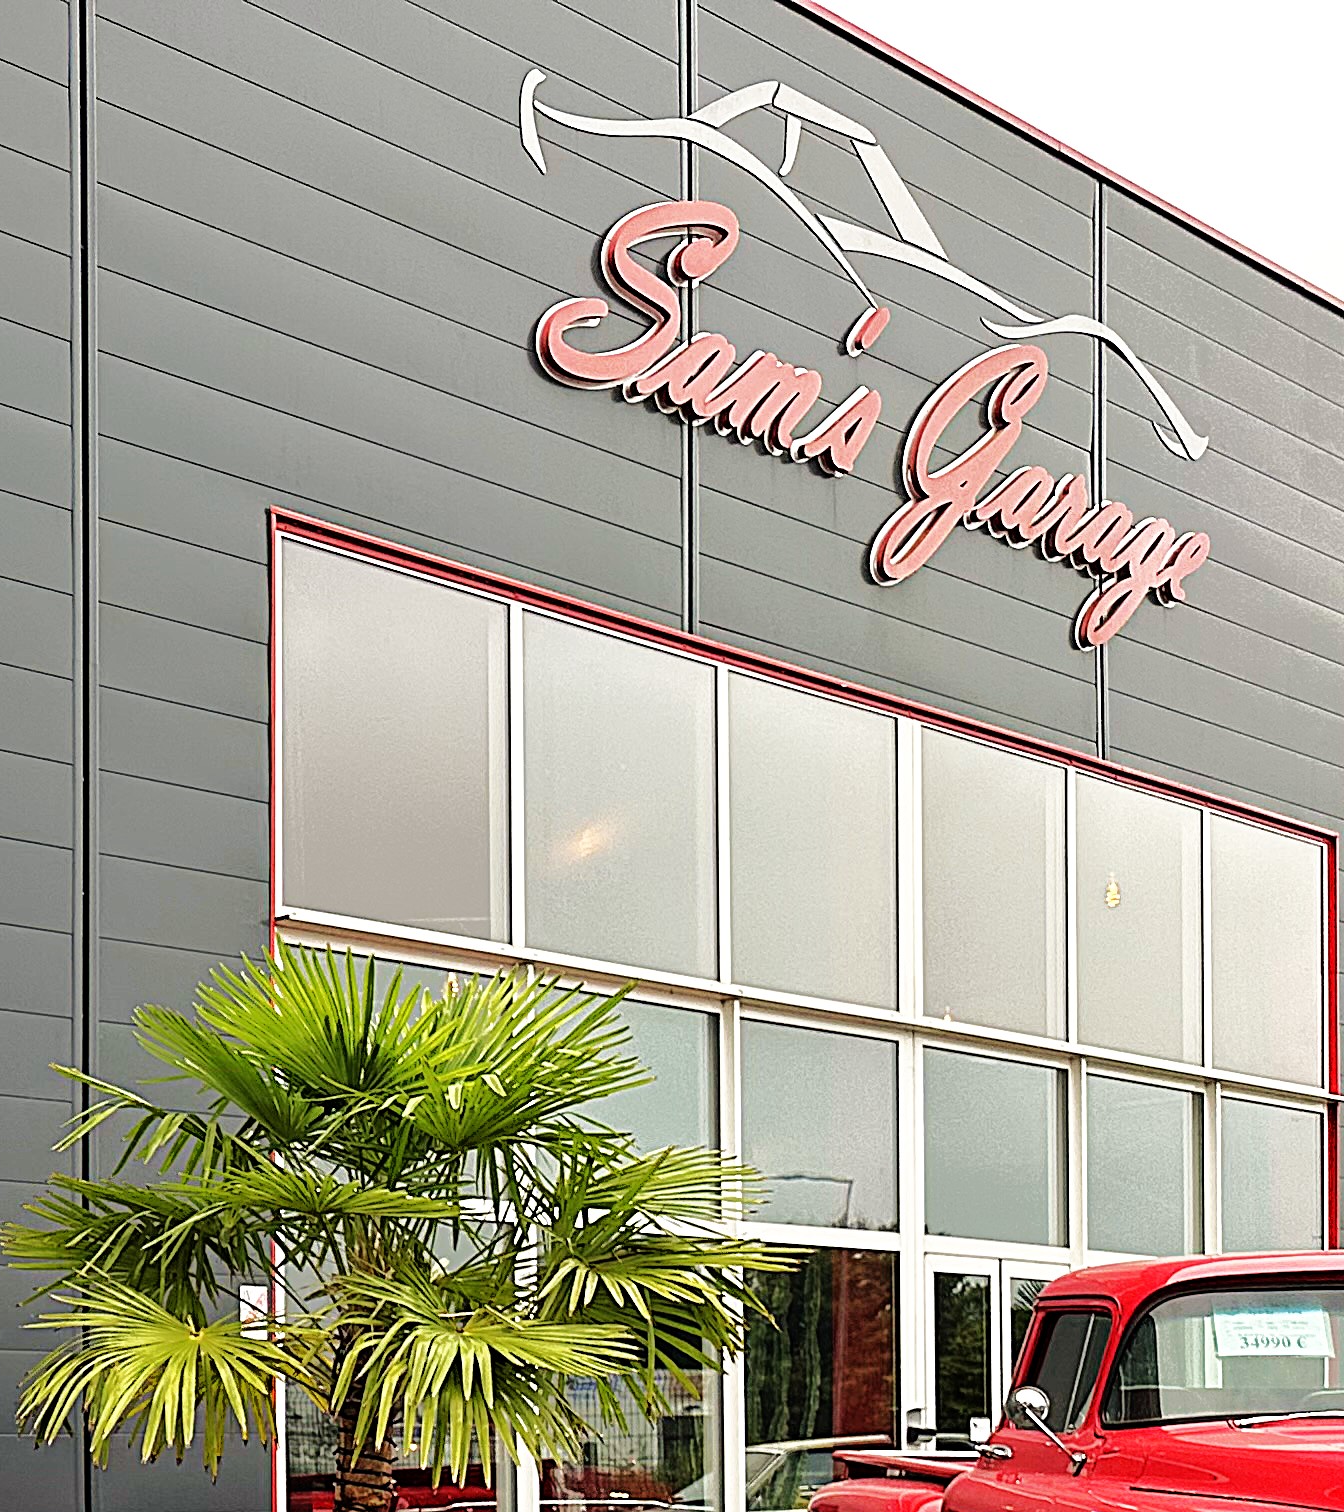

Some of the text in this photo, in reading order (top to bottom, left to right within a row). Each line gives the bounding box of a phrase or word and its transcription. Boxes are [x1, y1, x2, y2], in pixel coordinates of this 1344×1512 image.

[535, 200, 1211, 650] Sam's Garage
[1240, 1336, 1291, 1349] 34990
